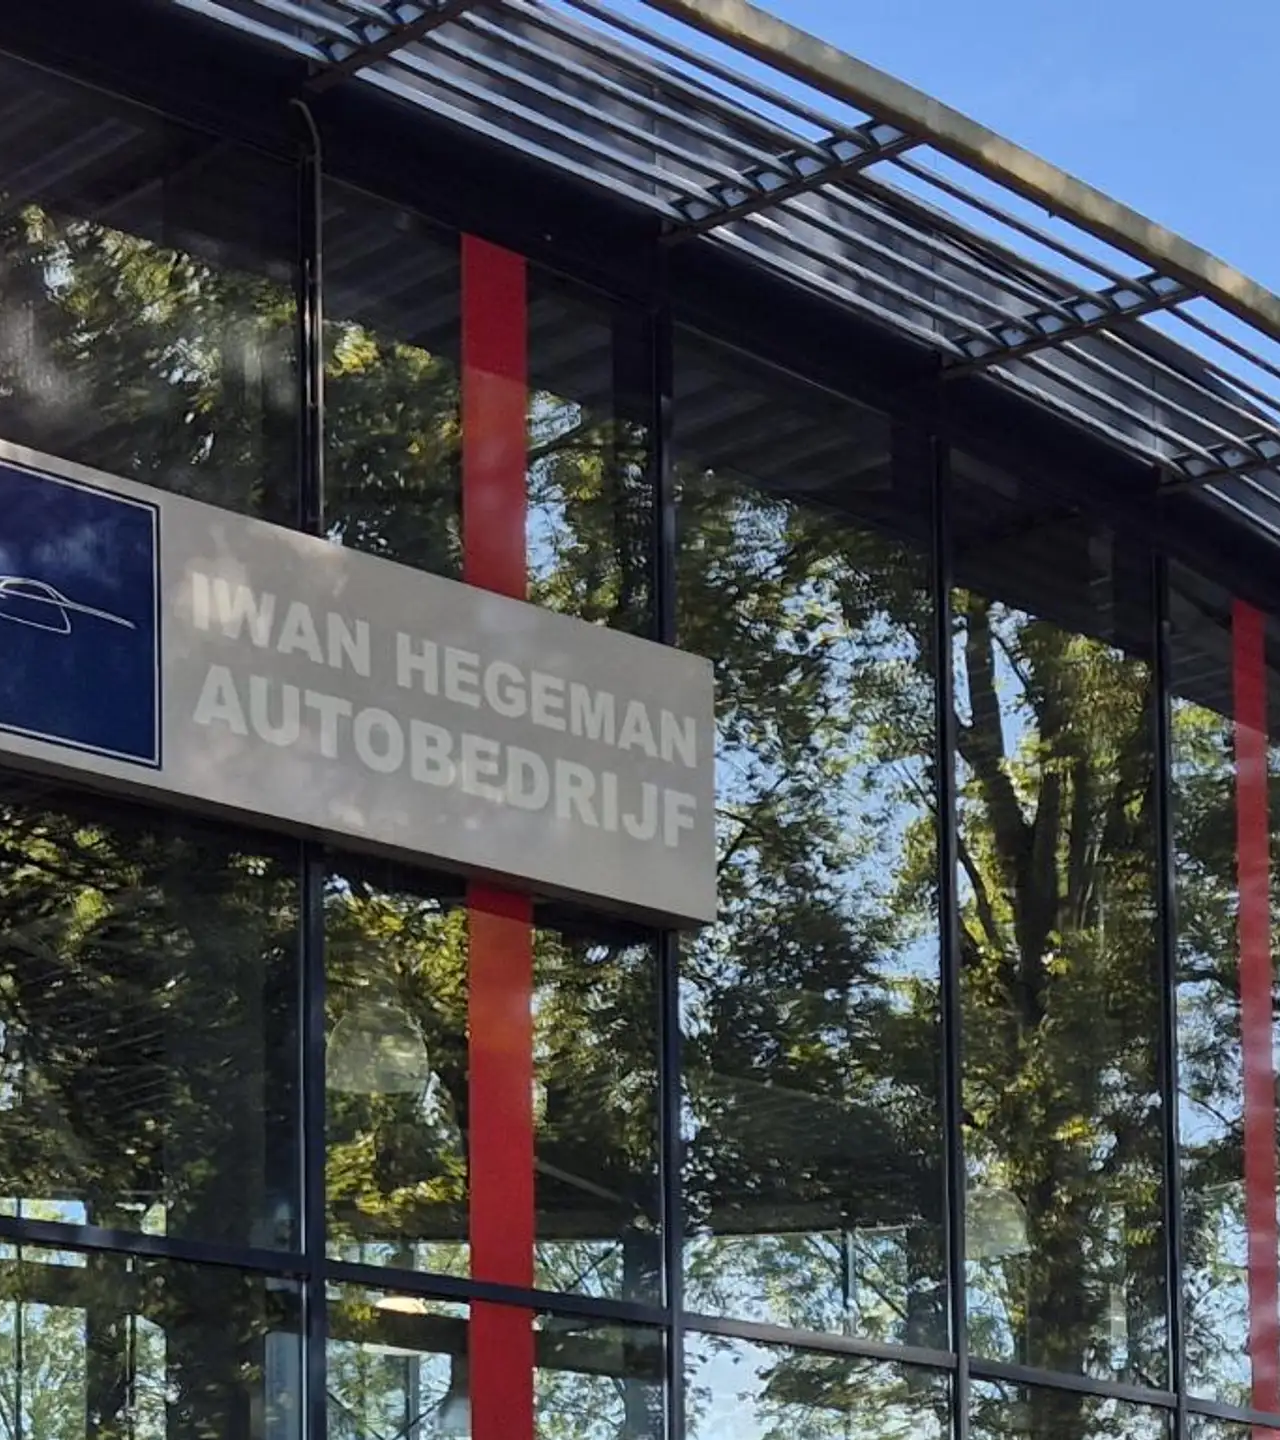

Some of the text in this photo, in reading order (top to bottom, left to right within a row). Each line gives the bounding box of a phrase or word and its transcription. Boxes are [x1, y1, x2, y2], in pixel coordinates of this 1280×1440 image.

[192, 571, 698, 769] IWAN HEGEMAN
[192, 662, 698, 848] AUTOBEDRIJF
